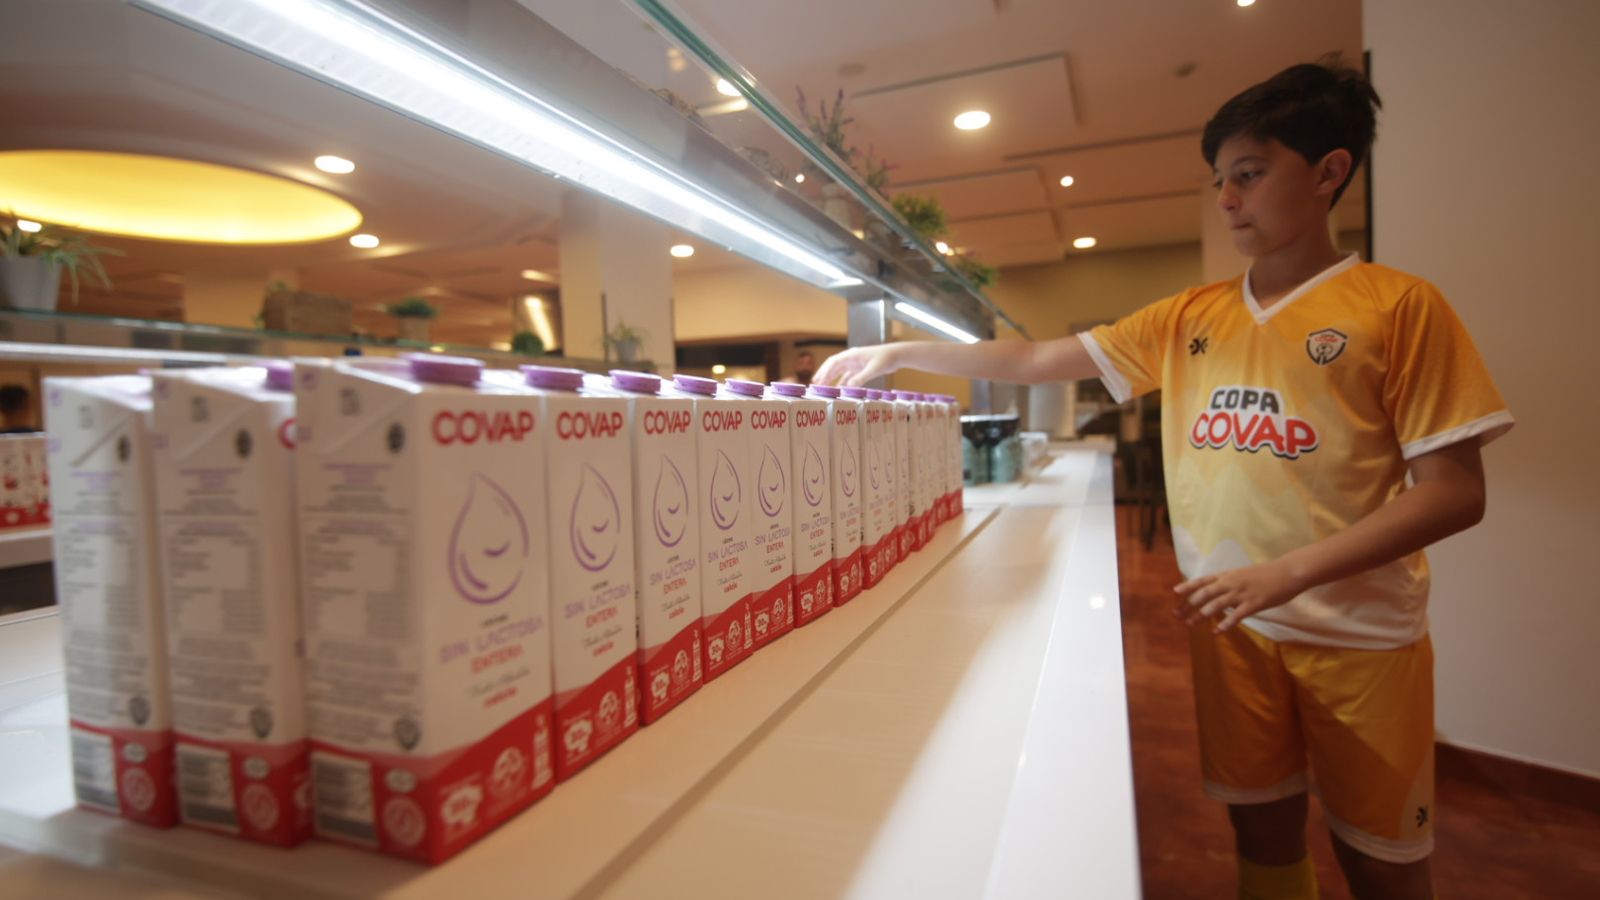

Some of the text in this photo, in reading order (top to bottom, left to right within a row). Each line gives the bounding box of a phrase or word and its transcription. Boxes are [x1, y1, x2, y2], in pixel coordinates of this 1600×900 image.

[1211, 390, 1280, 414] COPA
[431, 410, 535, 445] COVAP
[556, 411, 623, 440] COVAP
[643, 410, 691, 435] COVAP
[702, 410, 742, 432] COVAP
[750, 410, 786, 429] COVAP
[796, 410, 826, 427] COVAP
[1192, 412, 1316, 454] COVAP
